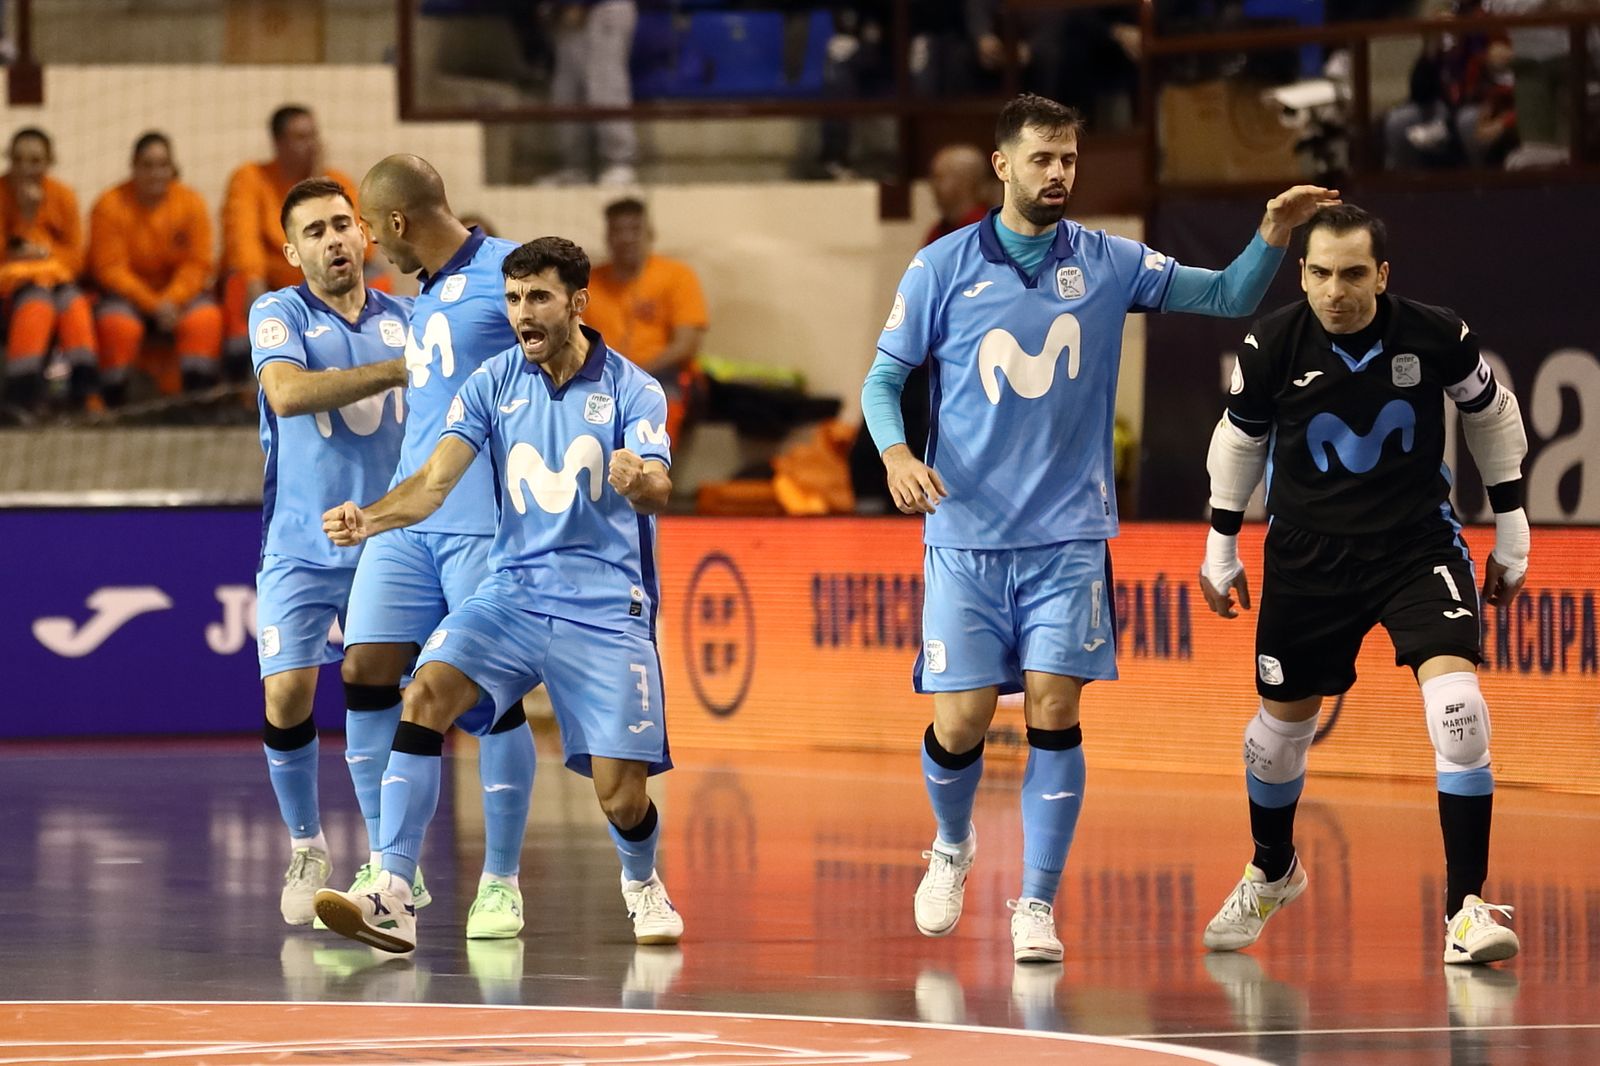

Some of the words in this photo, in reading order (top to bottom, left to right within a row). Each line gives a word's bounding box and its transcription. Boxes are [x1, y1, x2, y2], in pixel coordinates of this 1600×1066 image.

[1433, 565, 1462, 601] 1
[1116, 573, 1193, 658] PAÑA
[630, 663, 649, 711] 7
[1442, 715, 1478, 728] MARTINA
